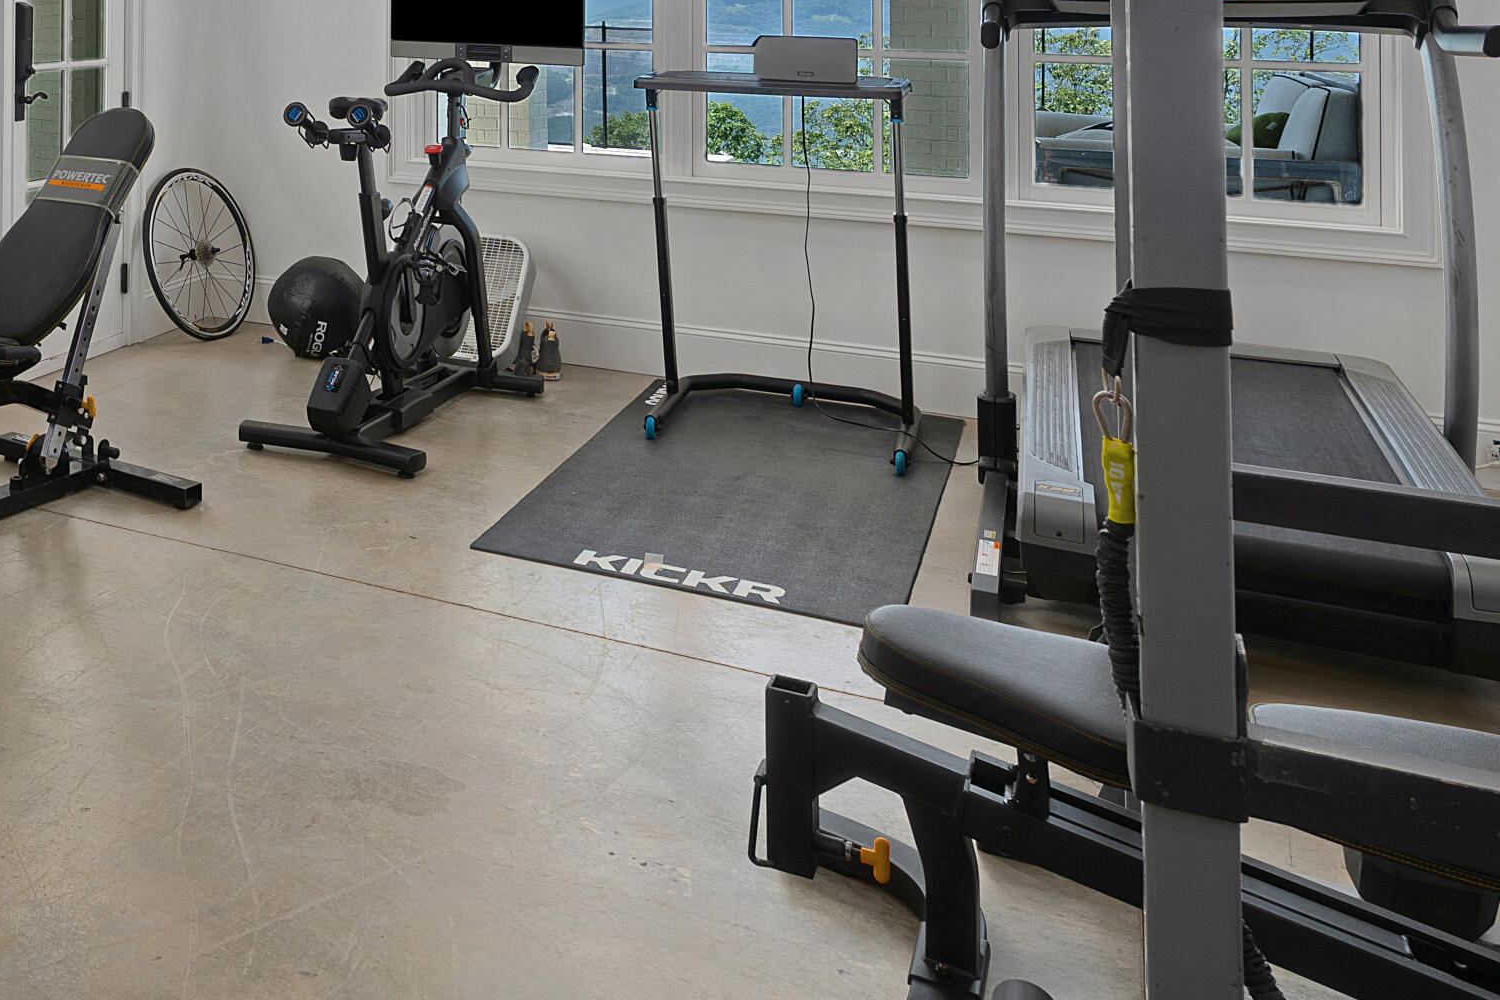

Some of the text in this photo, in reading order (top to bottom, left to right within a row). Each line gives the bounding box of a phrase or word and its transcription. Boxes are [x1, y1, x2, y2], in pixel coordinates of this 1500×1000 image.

[52, 169, 111, 184] POWERTEC
[310, 320, 328, 357] ROGU
[573, 548, 786, 604] KICKR
